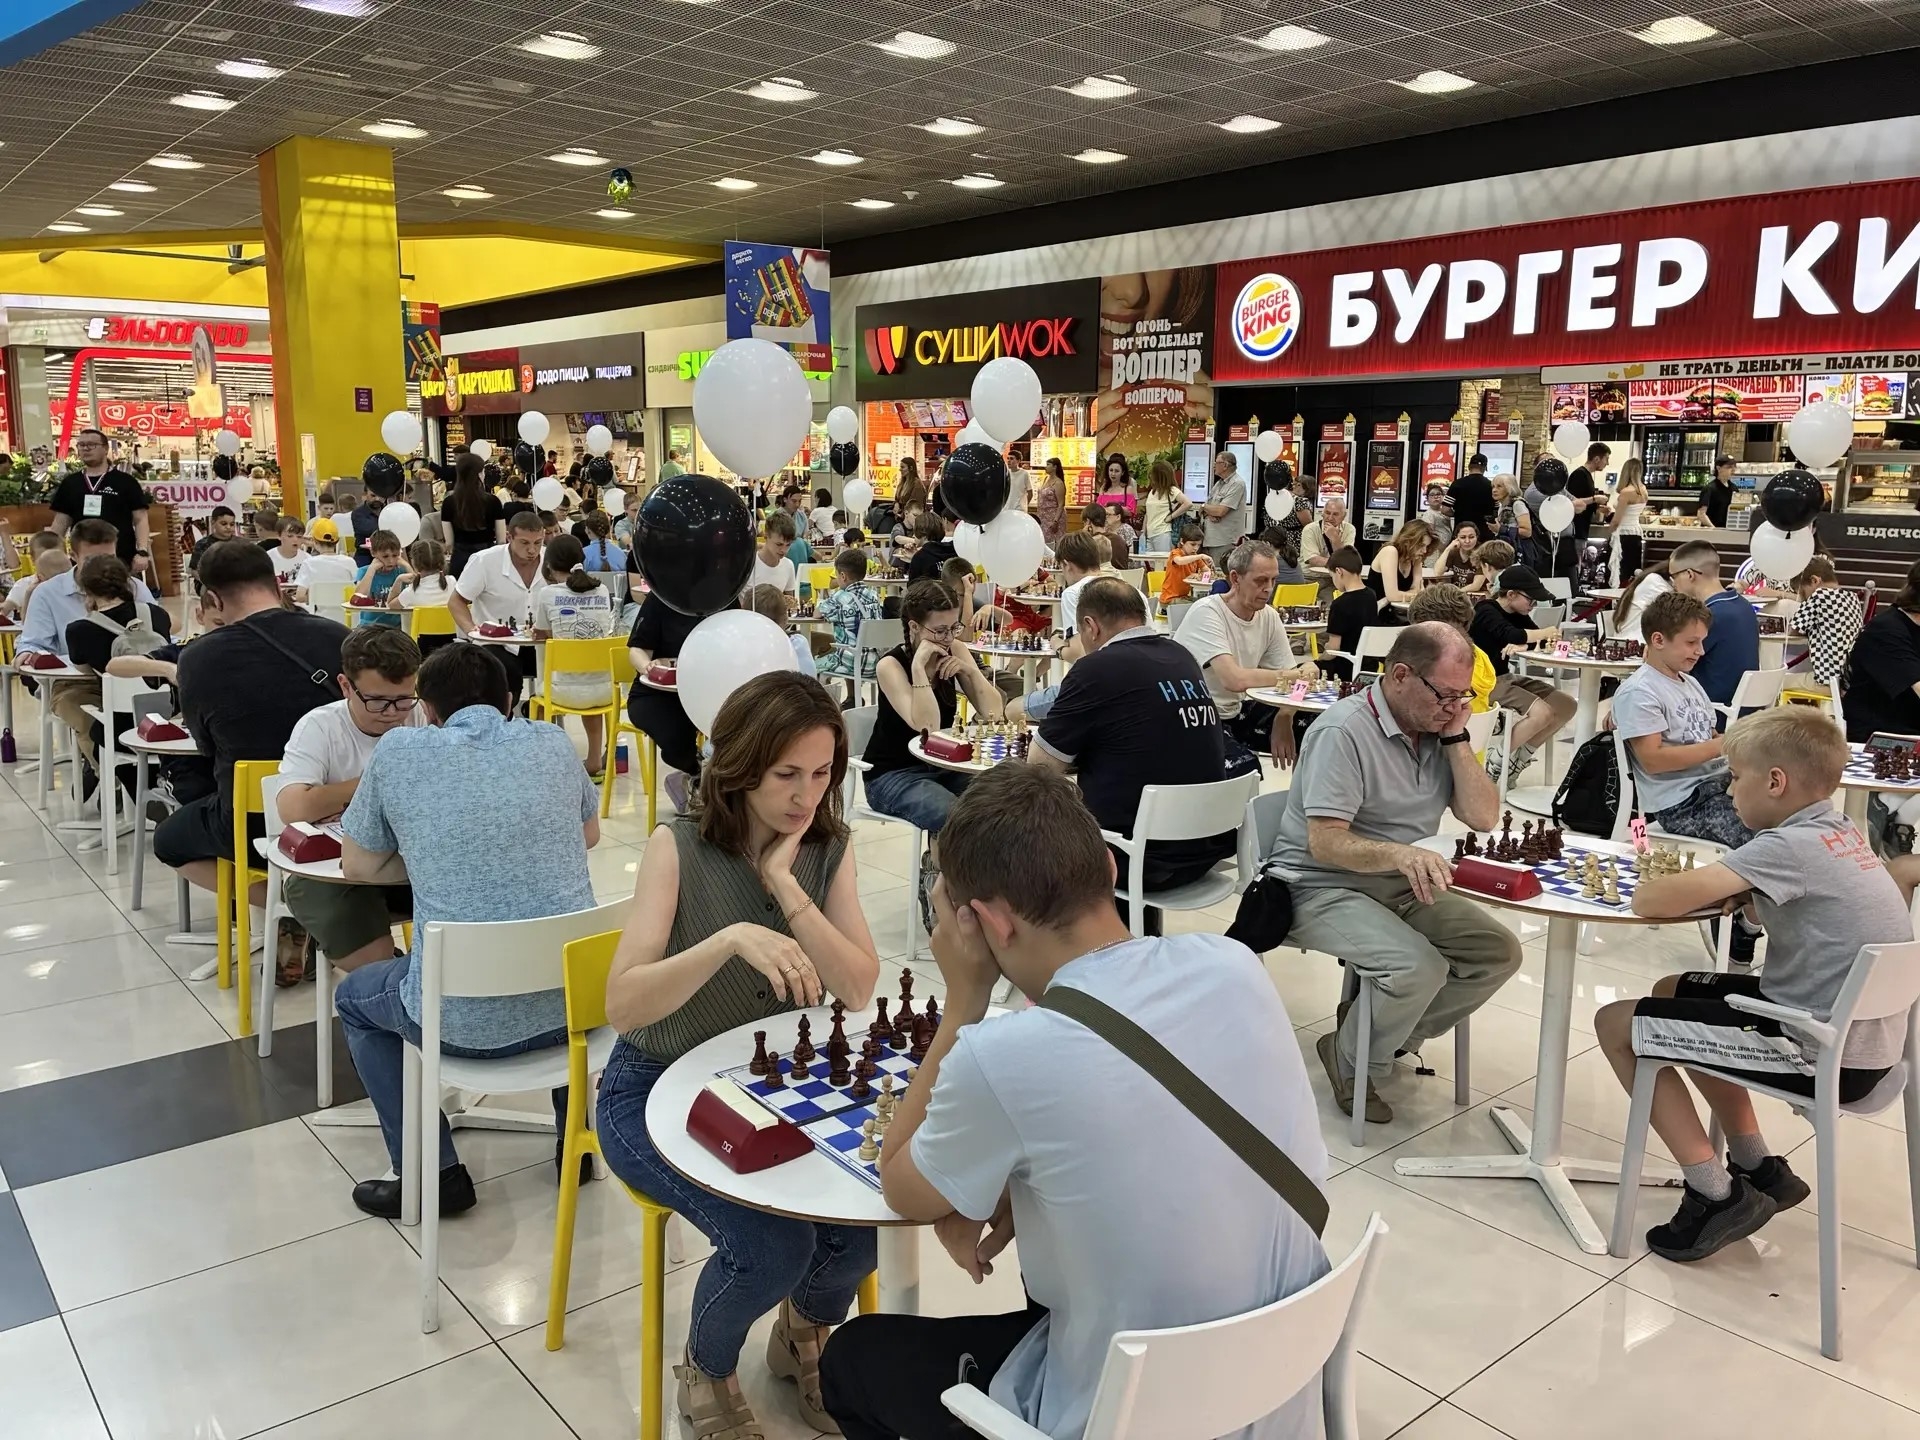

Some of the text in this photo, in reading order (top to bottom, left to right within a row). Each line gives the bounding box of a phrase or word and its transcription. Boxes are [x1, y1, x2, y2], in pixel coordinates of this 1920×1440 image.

[772, 288, 791, 302] DEPO
[1329, 237, 1708, 348] БУРГЕР
[762, 307, 779, 320] DEPO
[1241, 289, 1290, 321] BURGER
[1135, 319, 1171, 334] ОГОНЬ
[1243, 303, 1291, 343] KING
[1112, 332, 1204, 351] ВОТ ЧТО ДЕЛАЕТ
[595, 364, 633, 380] ПИЦЦЕРИЯ
[1111, 349, 1202, 391] ВОППЕР
[1659, 363, 1680, 377] НЕ
[1683, 361, 1734, 373] ТРАТЬ
[1736, 358, 1804, 374] ДЕНЬГИ
[1825, 355, 1889, 370] ПЛАТИ
[458, 368, 514, 395] КАРТОШКА
[536, 366, 589, 386] ДОДО ПИЦЦА
[1779, 375, 1795, 393] ТЫ
[1124, 387, 1184, 405] ВОППЕРОМ
[1630, 380, 1658, 397] ВКУС
[868, 470, 890, 480] WOK
[1557, 644, 1568, 652] 18
[1178, 705, 1216, 728] 1970
[1633, 825, 1646, 838] 12
